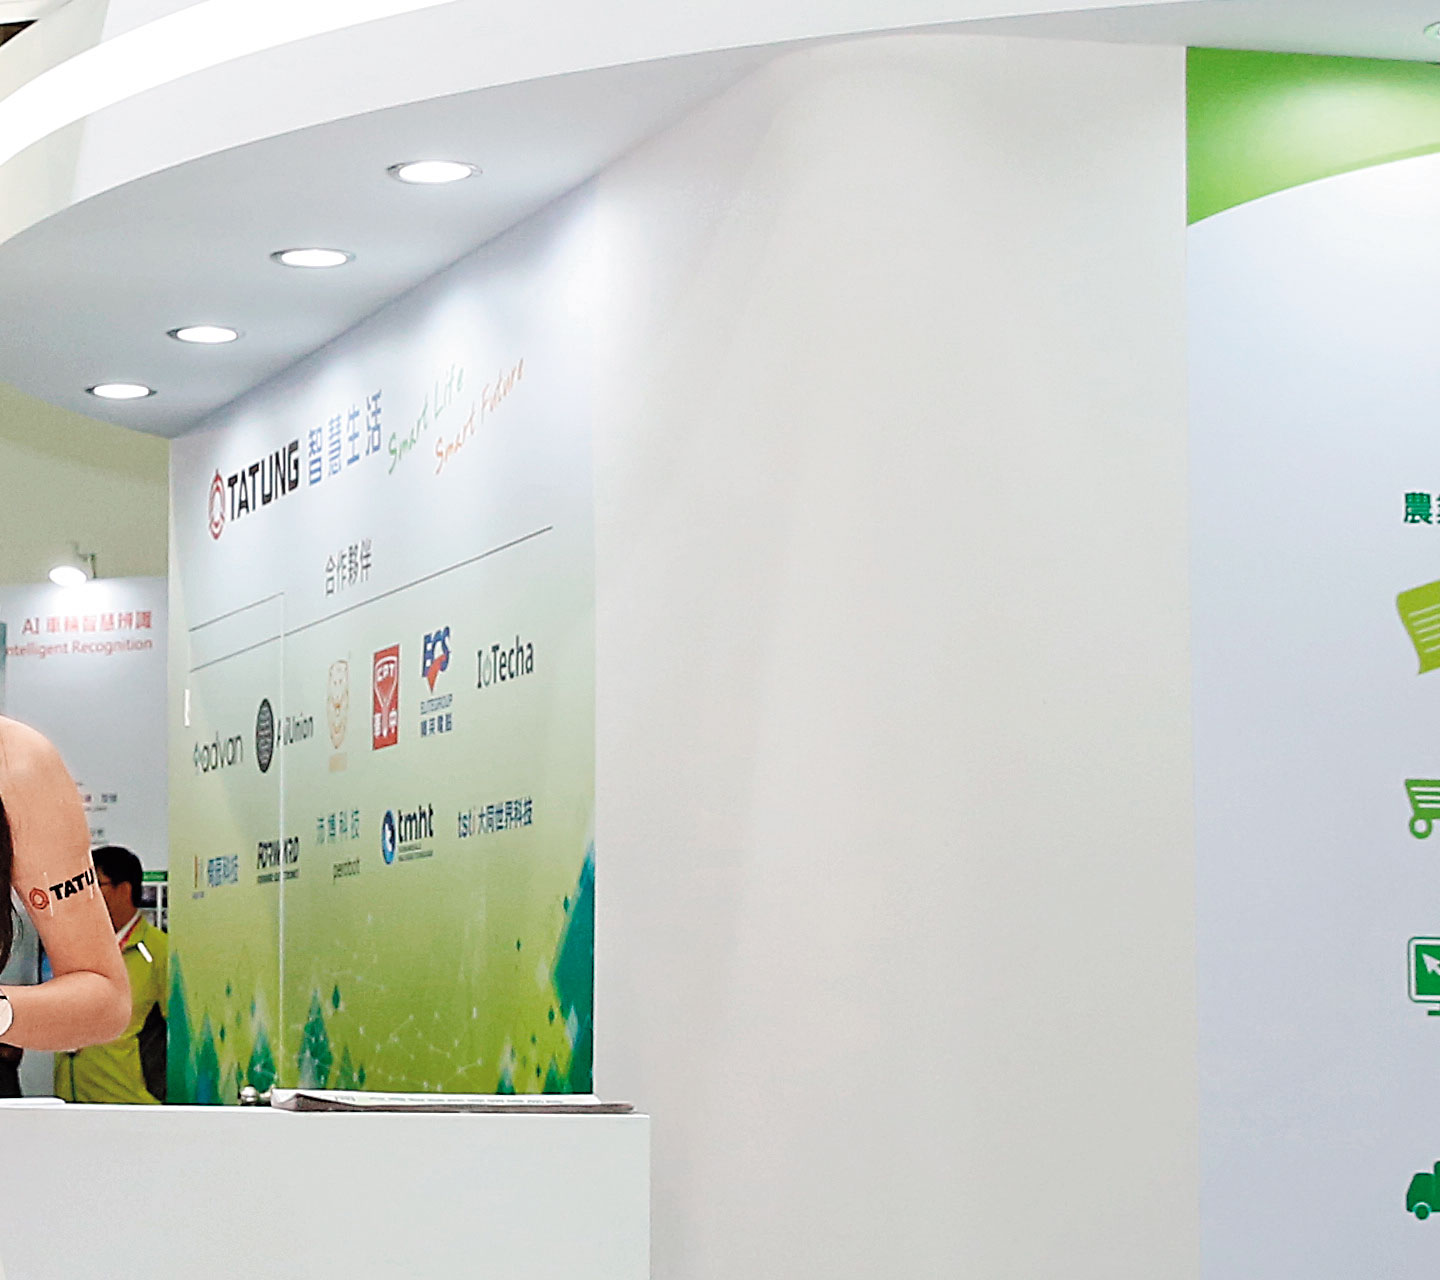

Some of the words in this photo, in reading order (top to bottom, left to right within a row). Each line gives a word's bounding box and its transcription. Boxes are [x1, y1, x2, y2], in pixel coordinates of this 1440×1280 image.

[308, 389, 382, 487] 智慧生活
[388, 394, 430, 475] Smart
[433, 364, 464, 419] Life
[435, 408, 476, 475] Smart
[480, 357, 524, 424] Future
[226, 439, 300, 521] TATUNG
[6, 642, 69, 659] ntelligent
[49, 868, 95, 900] TATU
